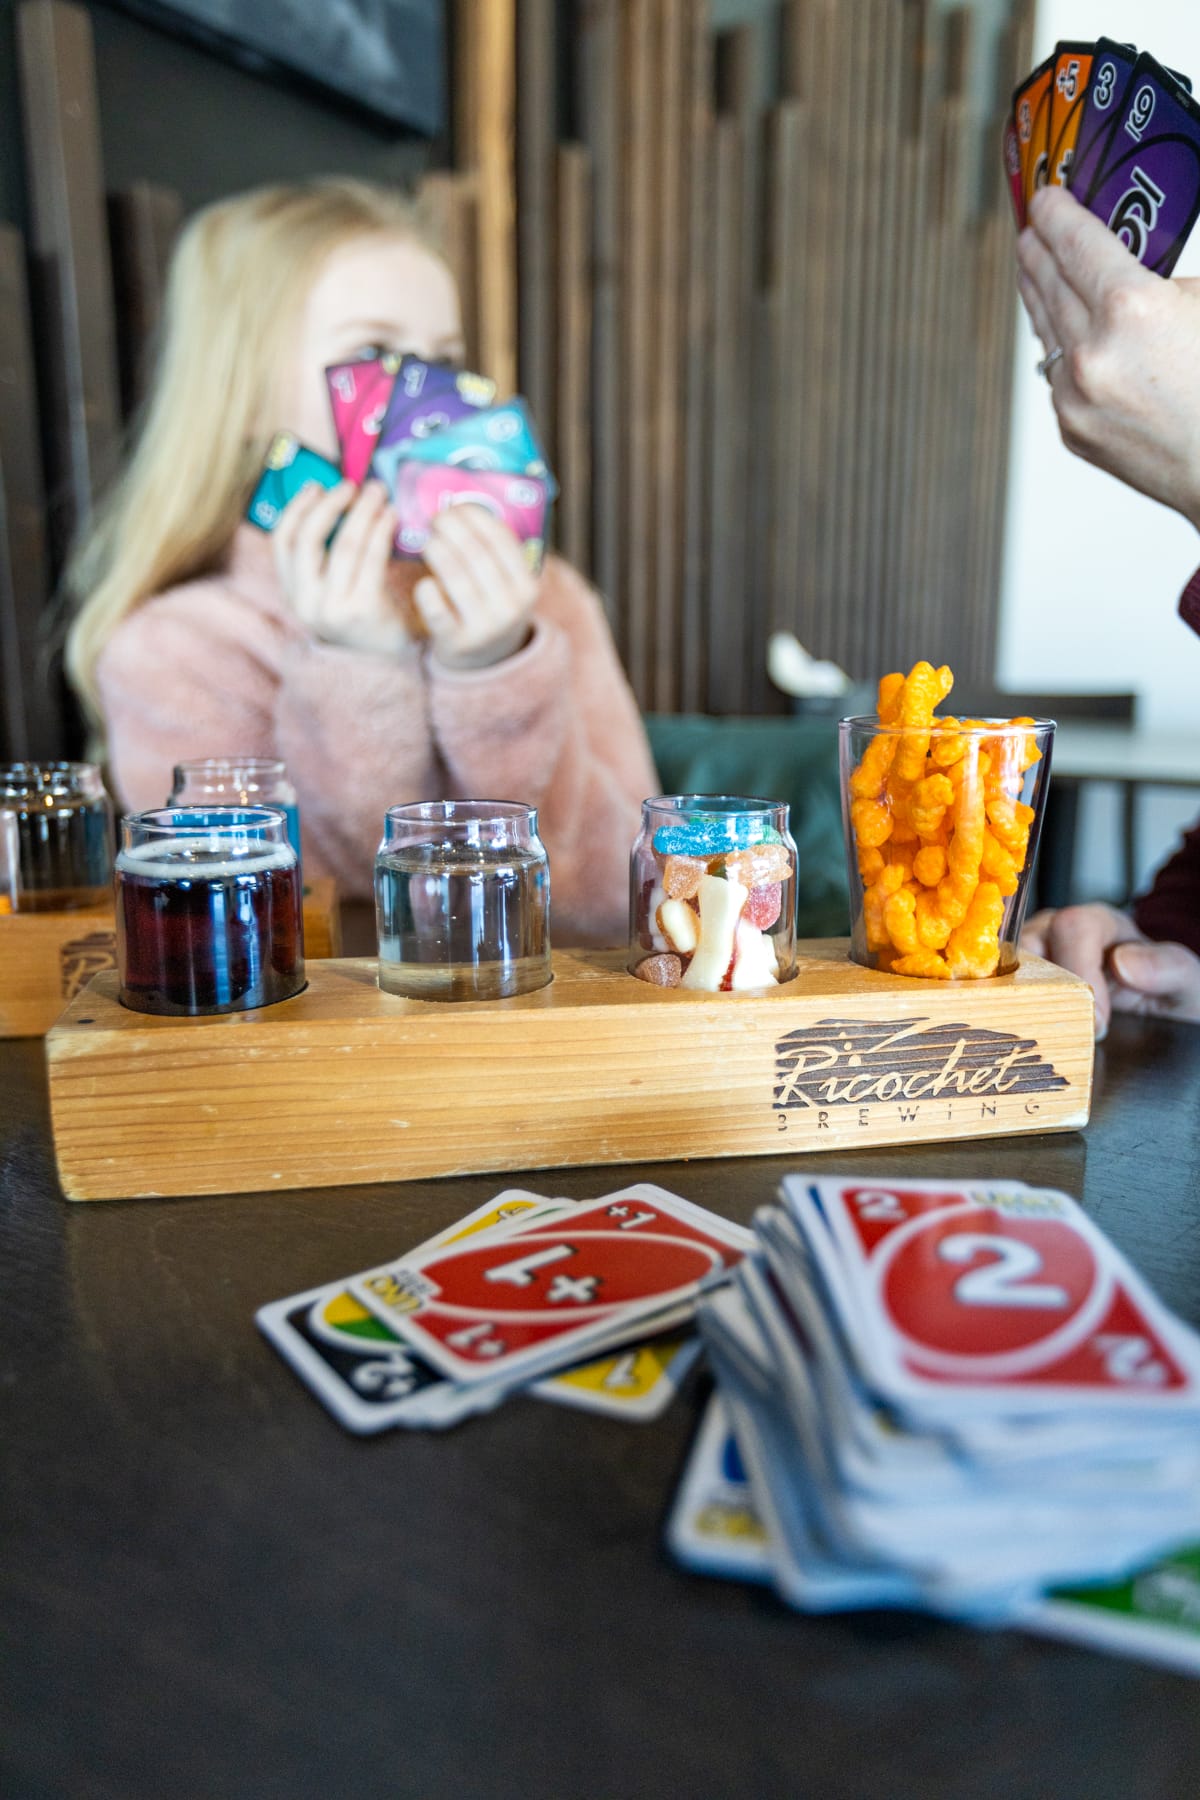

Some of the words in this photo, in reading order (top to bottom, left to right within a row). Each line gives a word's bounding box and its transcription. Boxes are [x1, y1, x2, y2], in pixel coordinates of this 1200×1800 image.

[1093, 62, 1116, 109] 3
[1125, 85, 1155, 141] 9
[775, 1036, 1042, 1107] Ricochet
[777, 1098, 1040, 1132] BREWING
[853, 1191, 906, 1220] 2
[937, 1231, 1069, 1309] 2
